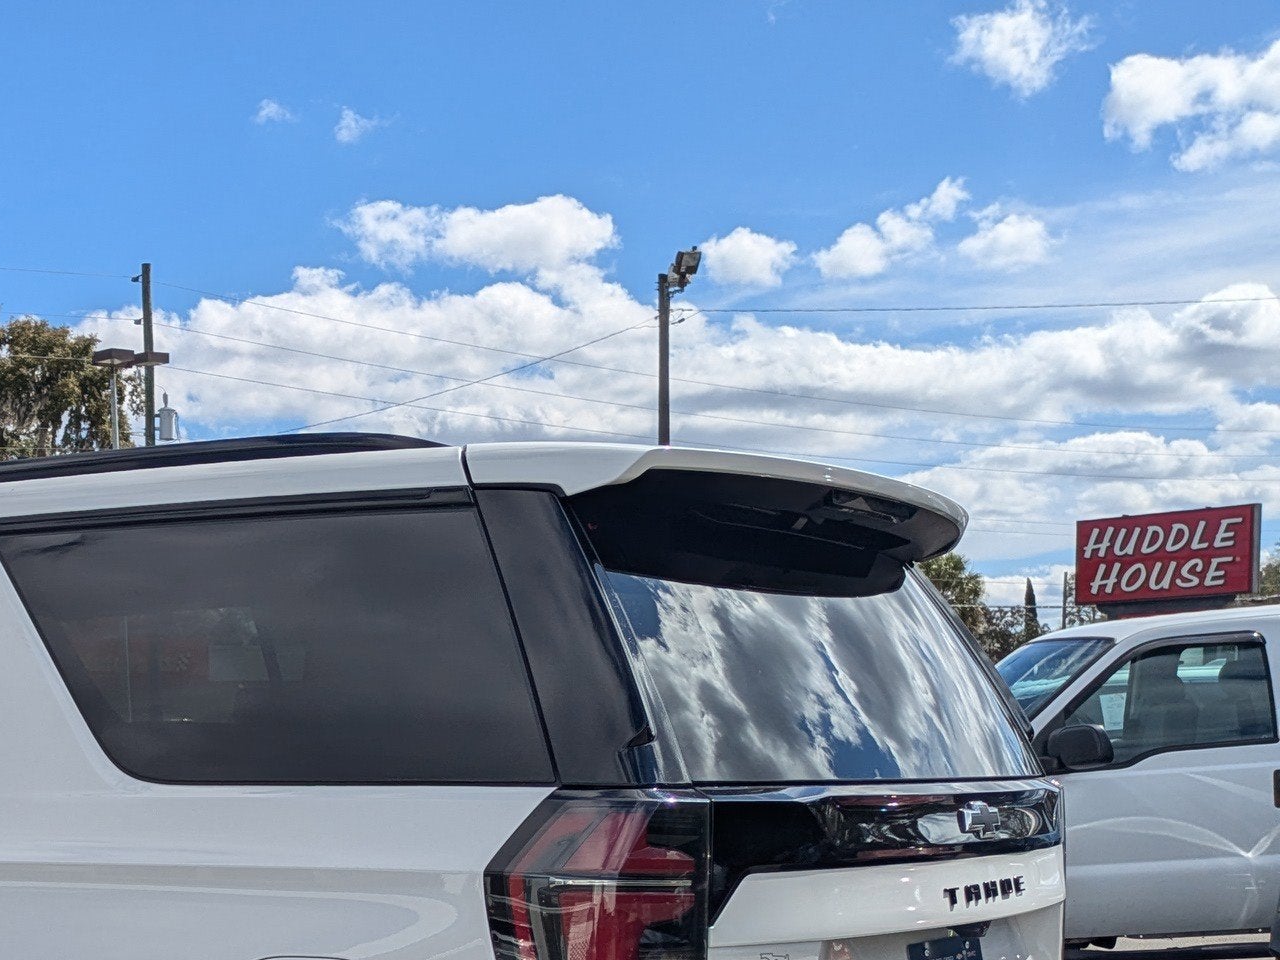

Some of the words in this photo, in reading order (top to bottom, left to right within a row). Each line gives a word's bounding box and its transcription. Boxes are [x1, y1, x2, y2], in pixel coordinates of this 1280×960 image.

[1083, 517, 1243, 559] HUDDLE
[1089, 556, 1234, 595] HOUSE
[943, 875, 1026, 908] TAHOE
